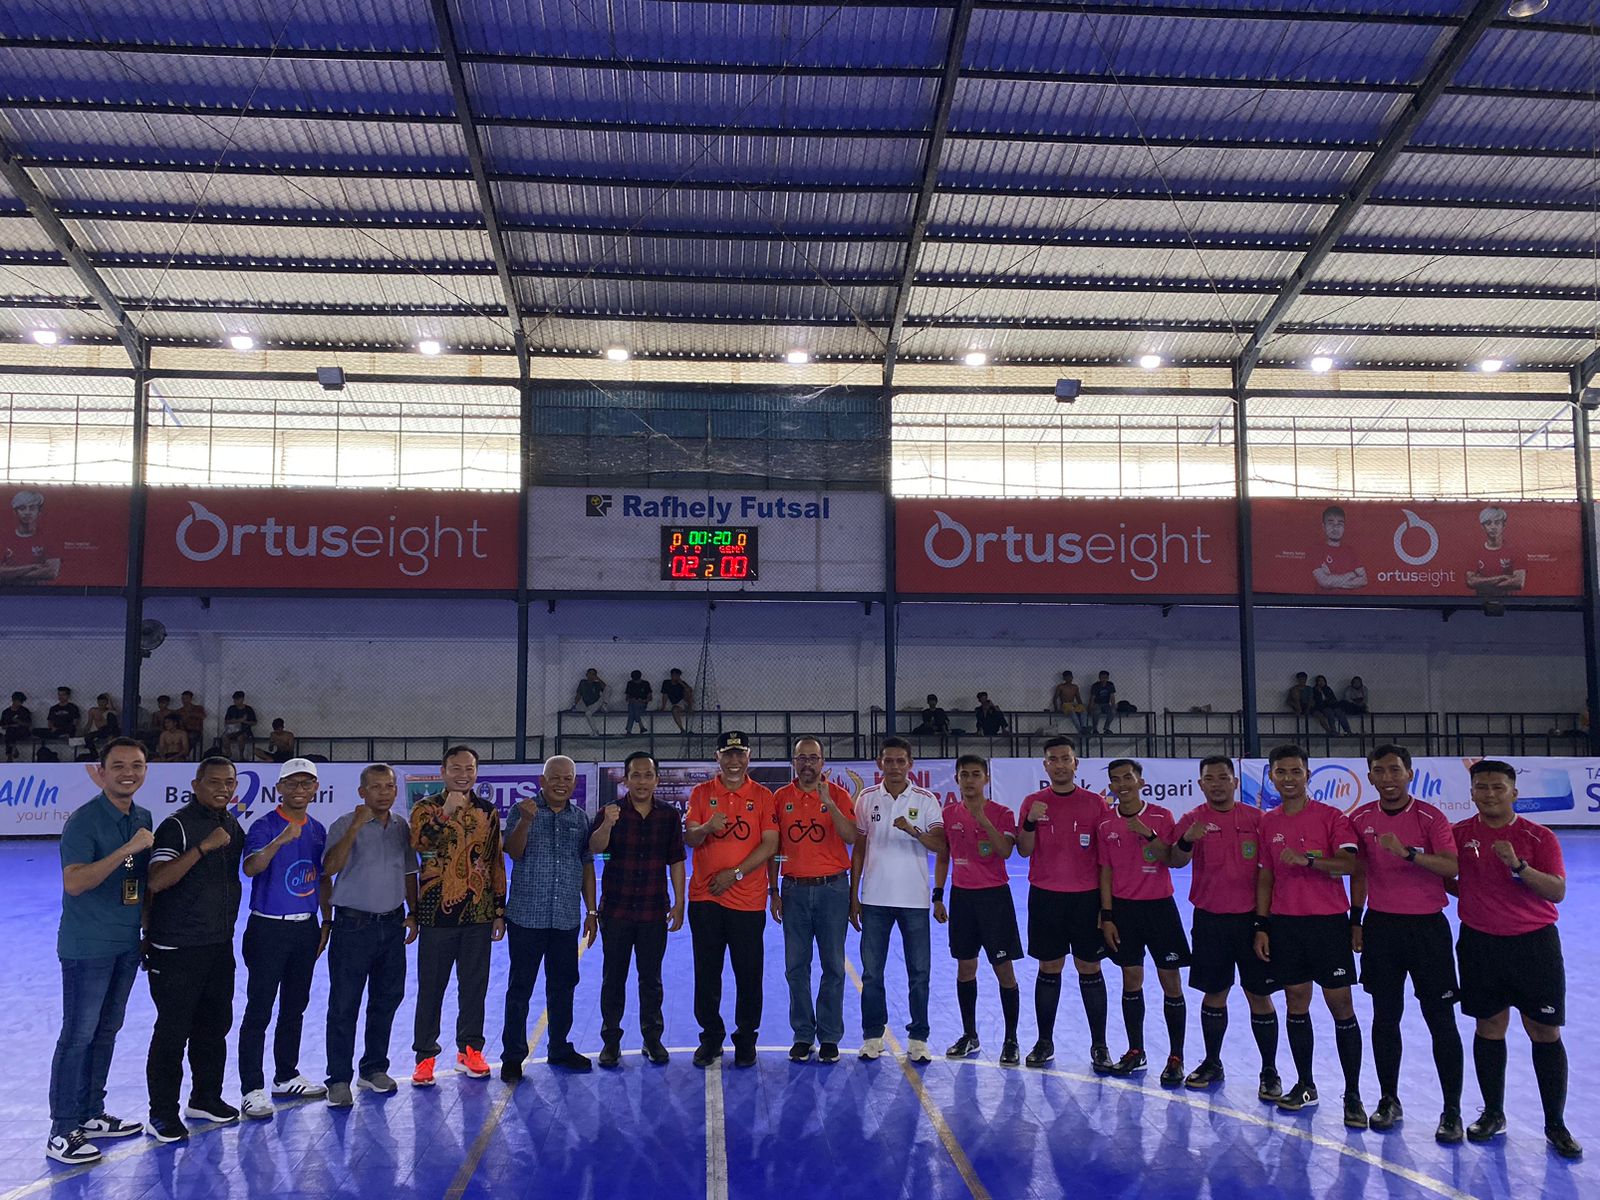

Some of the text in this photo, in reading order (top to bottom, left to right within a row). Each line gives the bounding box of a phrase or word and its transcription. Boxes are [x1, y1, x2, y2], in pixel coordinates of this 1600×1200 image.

[623, 495, 830, 524] Rafhely Futsal
[688, 531, 732, 545] 00:20
[671, 556, 748, 577] 02 2 00
[1377, 569, 1456, 588] ortuseight
[0, 775, 59, 808] All In
[1142, 779, 1193, 800] agari
[1440, 800, 1471, 810] hand
[16, 810, 49, 823] your
[871, 813, 881, 822] HD
